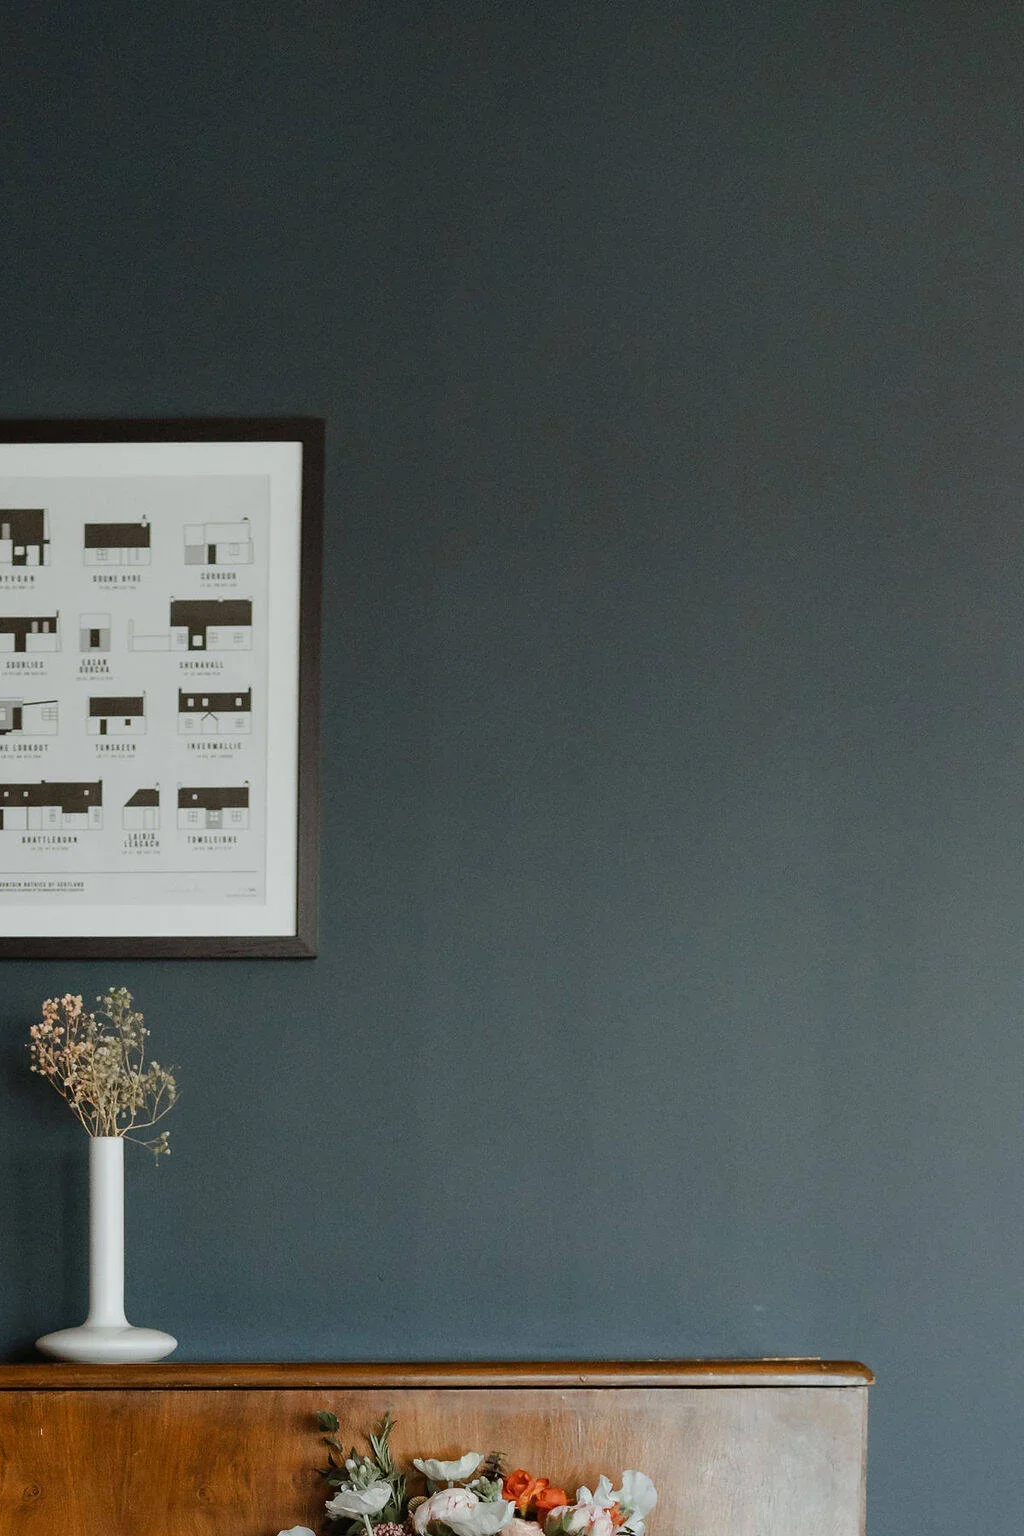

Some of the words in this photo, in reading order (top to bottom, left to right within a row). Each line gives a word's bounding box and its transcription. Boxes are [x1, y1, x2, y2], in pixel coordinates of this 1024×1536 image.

[12, 744, 49, 752] LOOKOUT
[187, 742, 243, 750] INVERMALLIE
[22, 836, 78, 844] BRATTLEBURN
